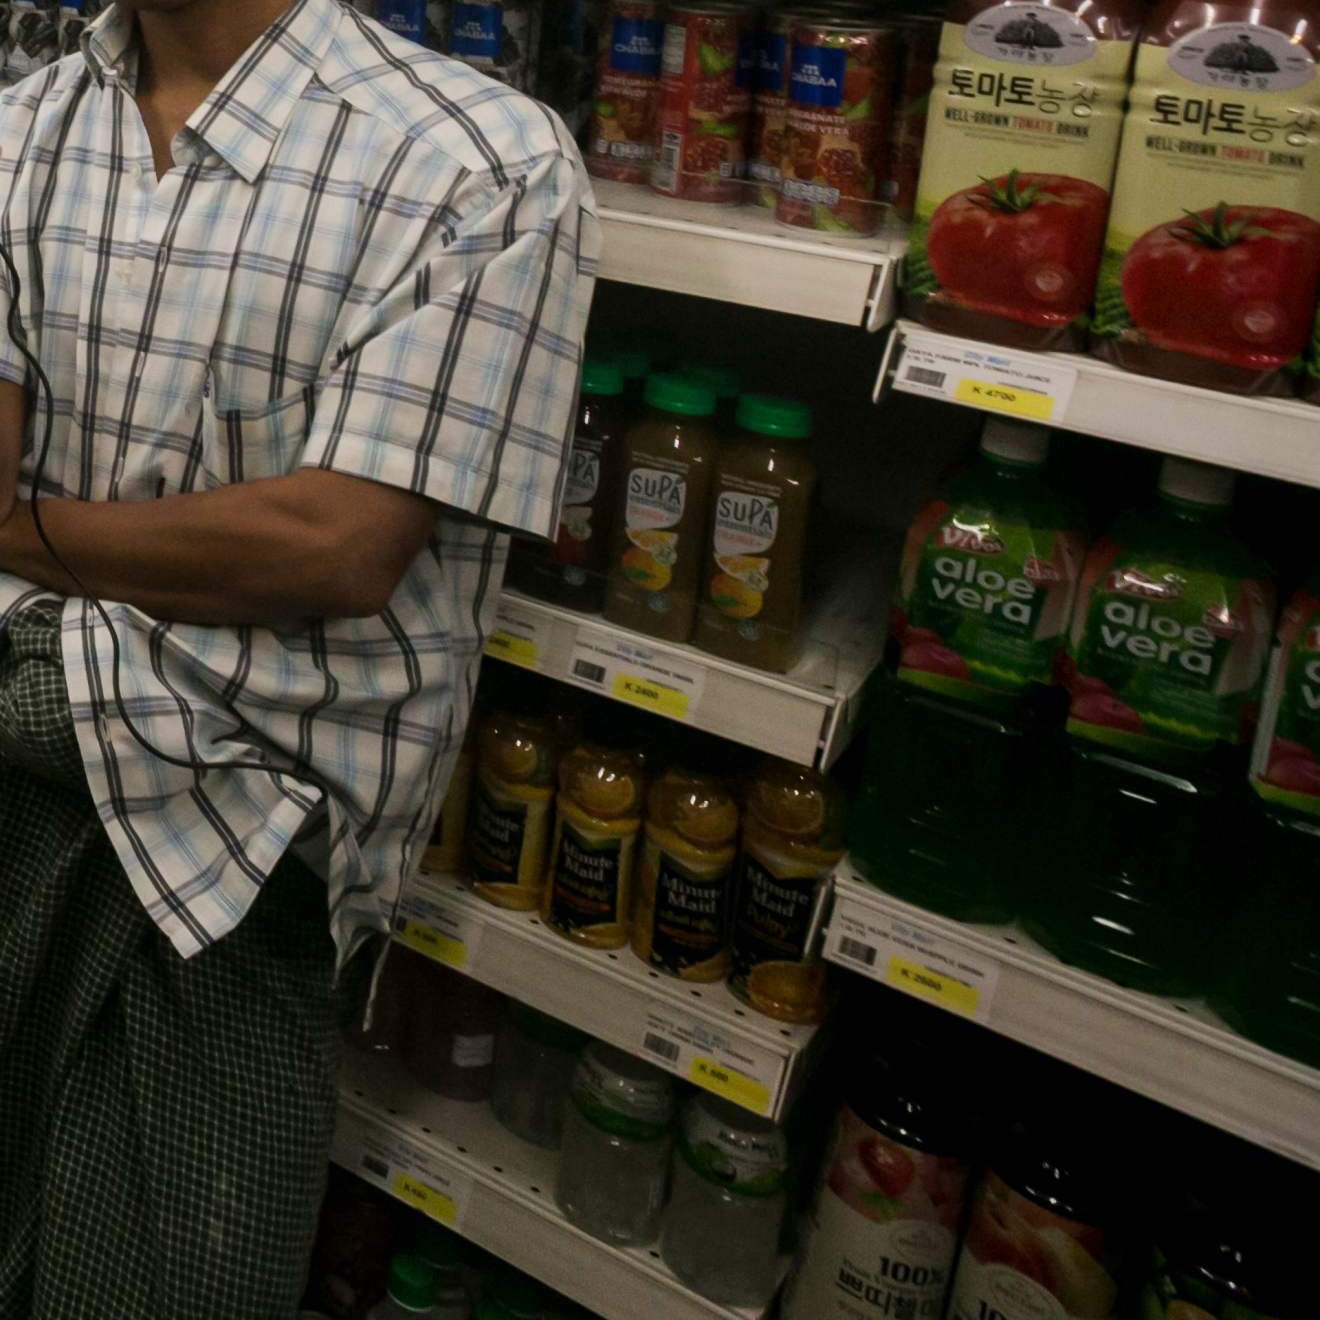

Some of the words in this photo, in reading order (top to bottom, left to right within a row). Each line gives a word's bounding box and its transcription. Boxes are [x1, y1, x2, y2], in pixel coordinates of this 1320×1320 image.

[948, 68, 1102, 118] 토마토농장
[944, 106, 1010, 129] WELL-GROWN
[1057, 122, 1089, 139] DRINK
[1149, 93, 1320, 148] 토마토농장
[1145, 135, 1217, 158] WELL-GROWN
[1268, 151, 1305, 169] DRINK
[630, 473, 682, 506] SUPA
[717, 497, 773, 530] SUPA
[933, 555, 1037, 601] aloe
[929, 577, 1033, 626] vera
[1102, 600, 1217, 650] aloe
[1099, 624, 1212, 677] vera
[667, 889, 718, 914] Maid
